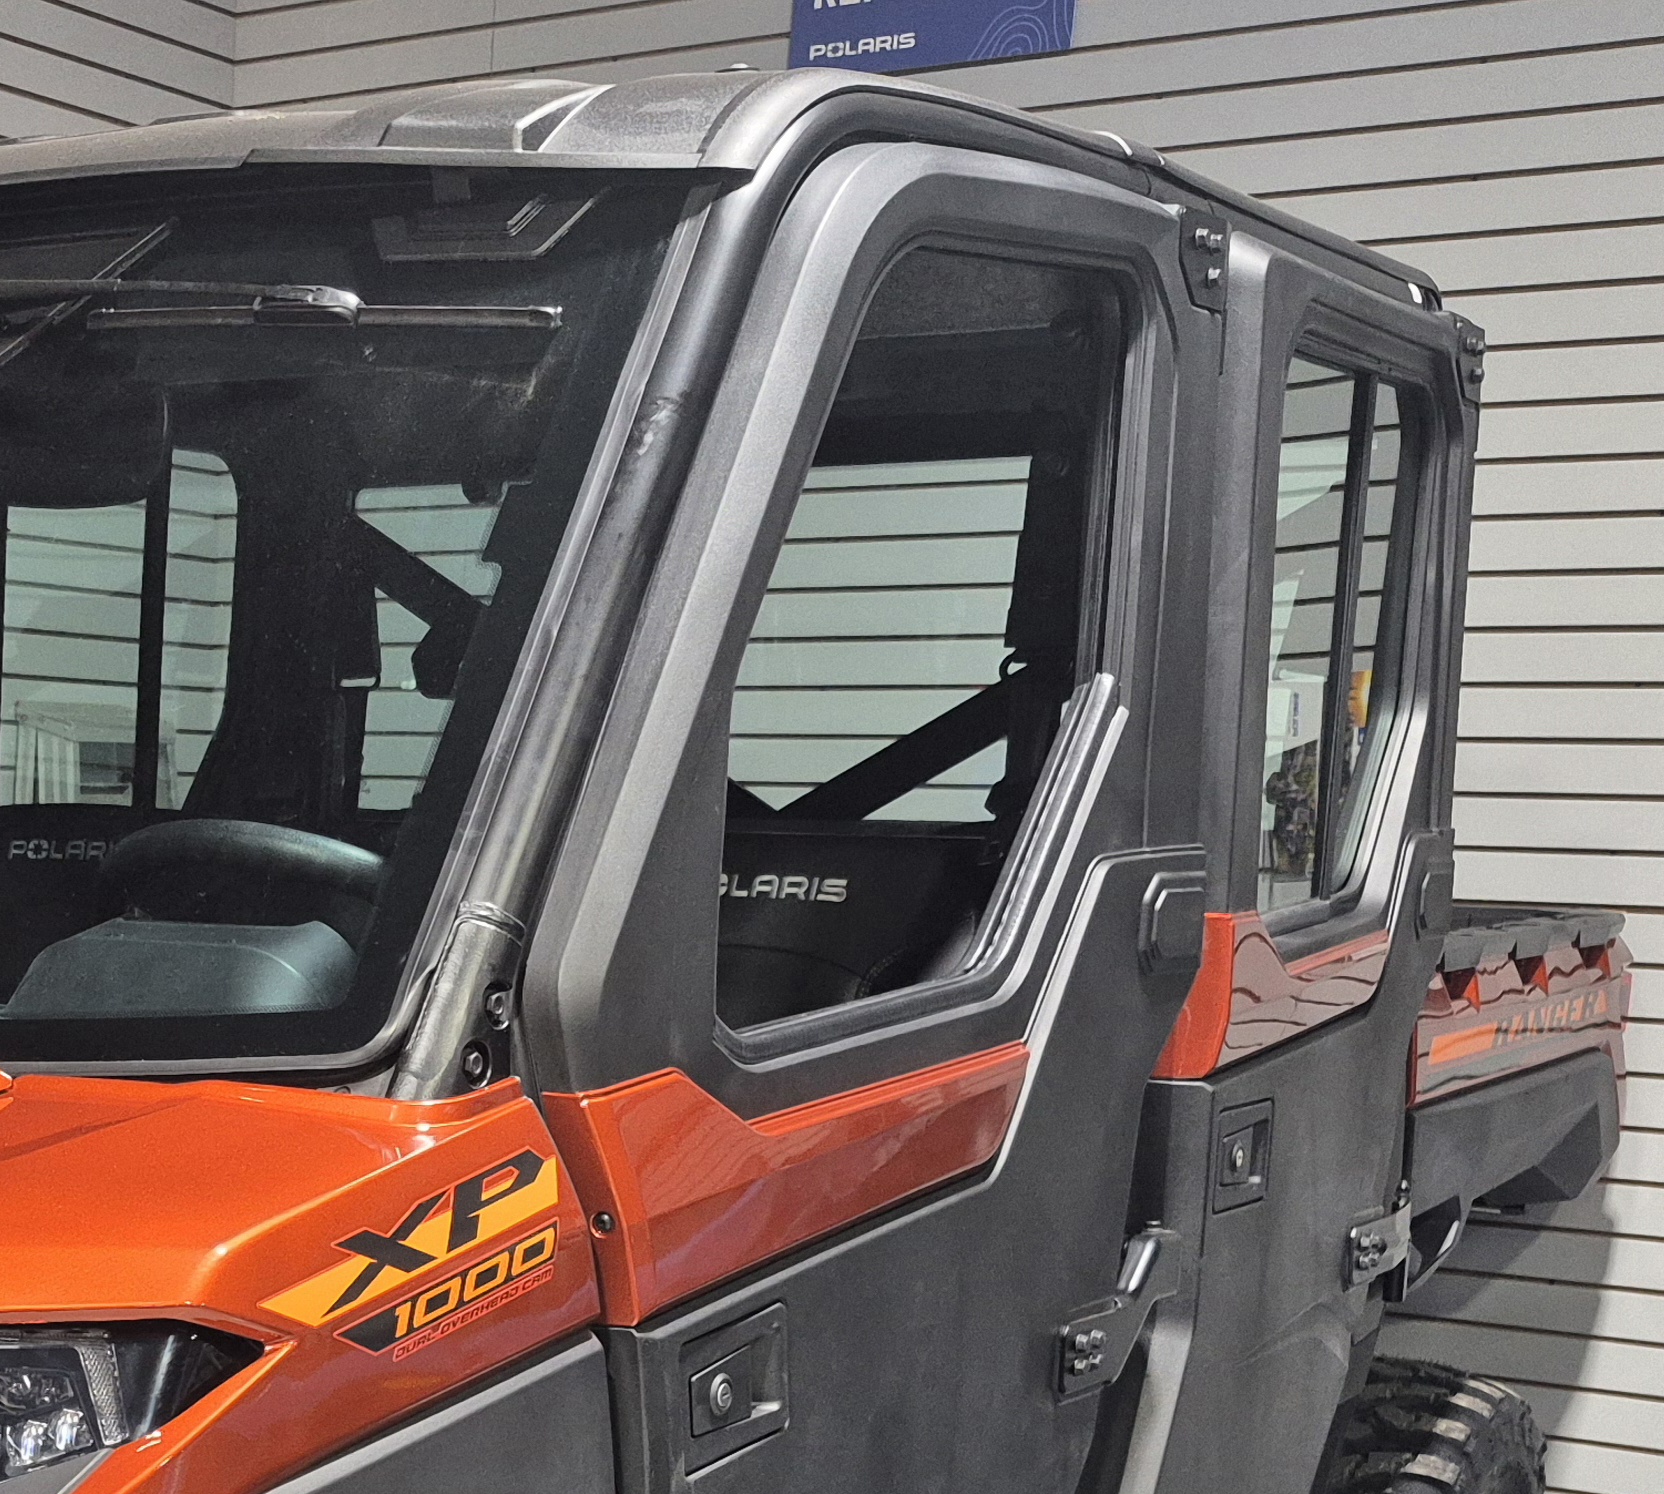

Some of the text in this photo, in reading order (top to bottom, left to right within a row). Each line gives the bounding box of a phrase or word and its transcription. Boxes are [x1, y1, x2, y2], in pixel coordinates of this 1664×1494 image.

[809, 32, 916, 61] POLARIS
[7, 839, 114, 861] POLAR
[718, 873, 848, 903] LARIS
[319, 1148, 546, 1319] XP
[394, 1227, 556, 1339] 1000
